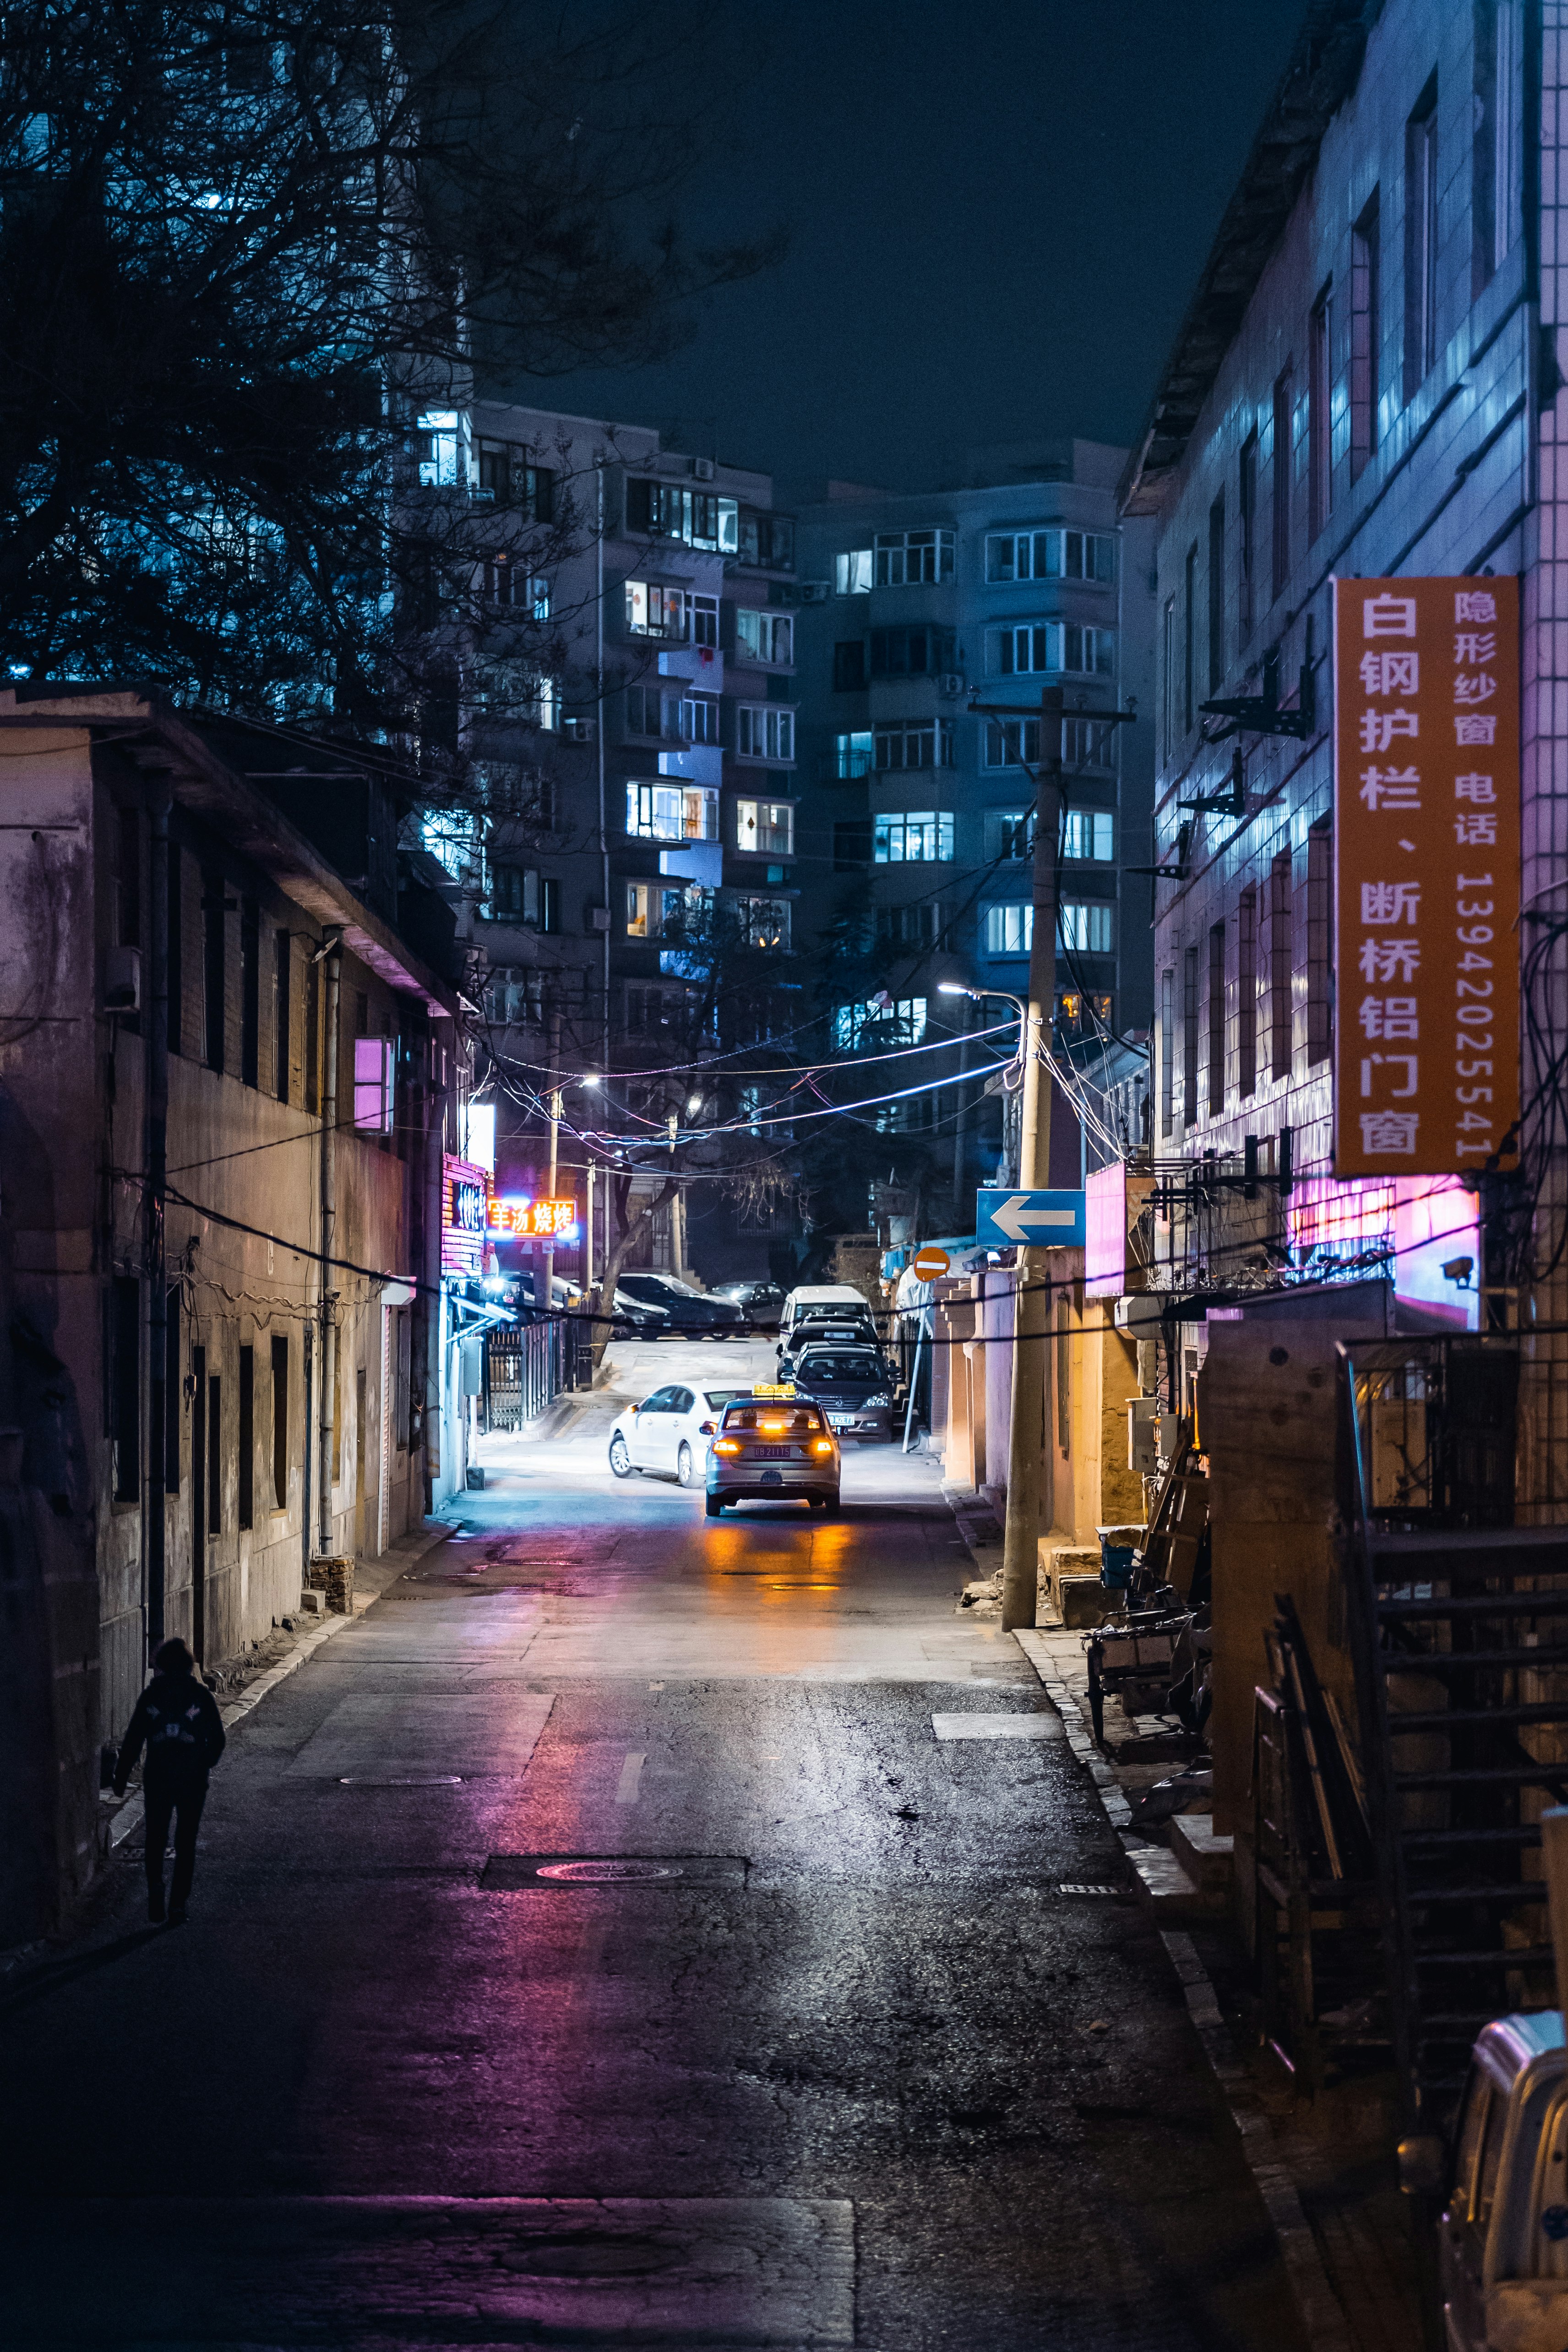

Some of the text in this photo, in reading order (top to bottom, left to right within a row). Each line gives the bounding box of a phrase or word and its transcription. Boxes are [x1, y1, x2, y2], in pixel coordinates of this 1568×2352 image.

[1359, 593, 1421, 1155] 白钢护栏、断桥铝门窗
[1454, 591, 1497, 1158] 隐形纱窗 电话 13942025541
